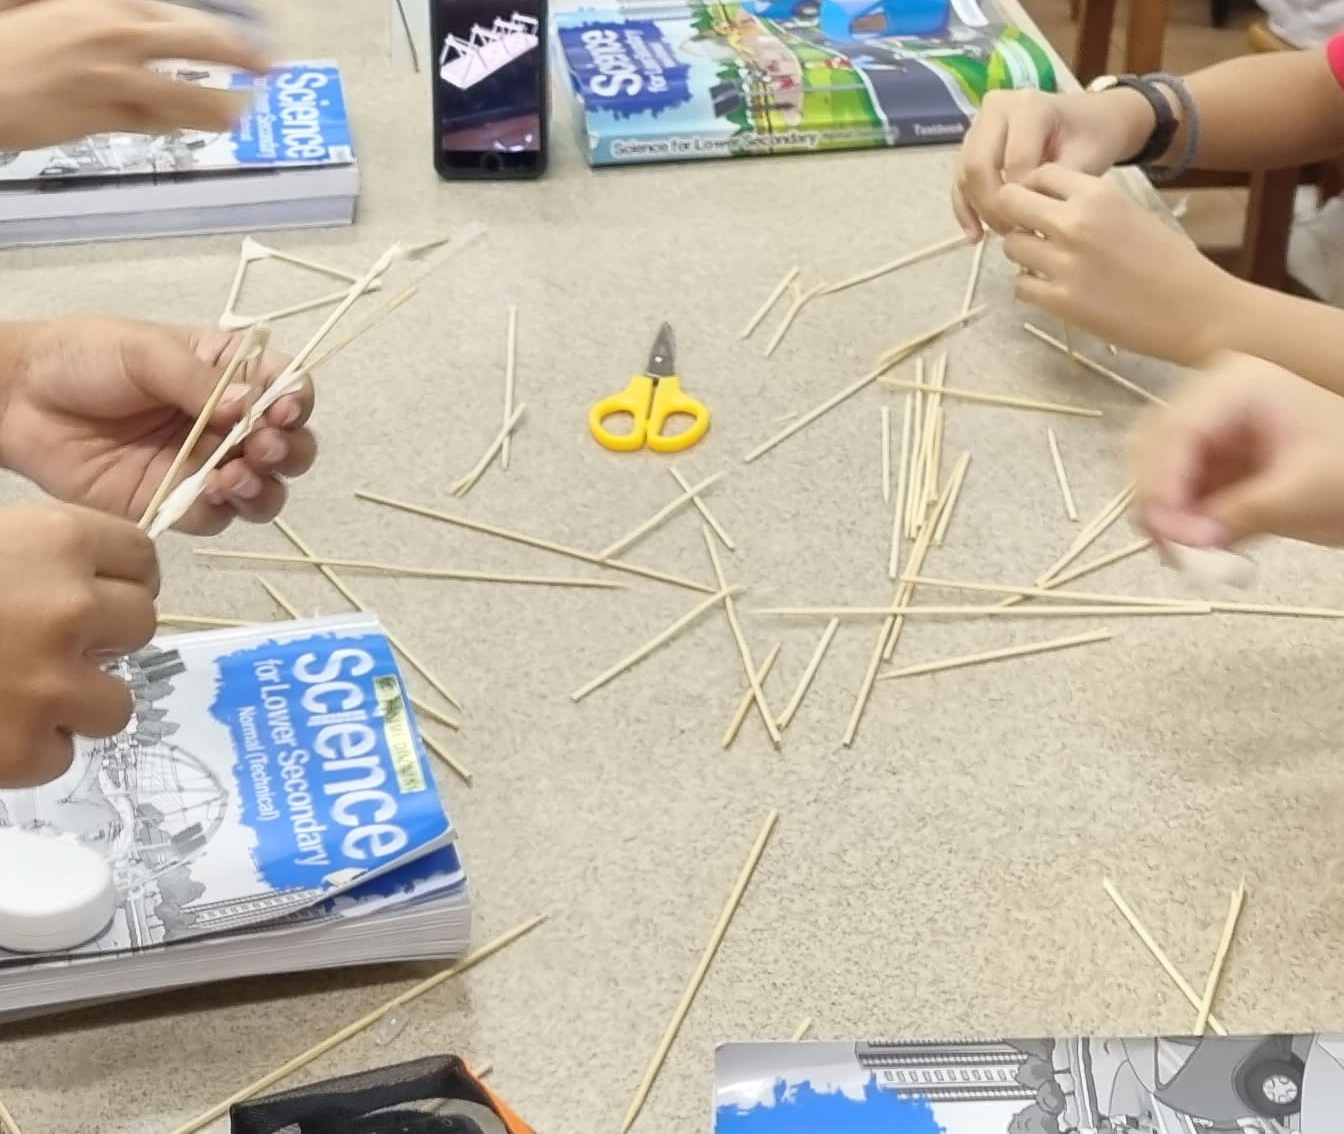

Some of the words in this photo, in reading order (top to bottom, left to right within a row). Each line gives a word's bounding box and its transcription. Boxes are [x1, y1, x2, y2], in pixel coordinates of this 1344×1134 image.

[276, 72, 331, 159] Science
[611, 139, 669, 157] Science
[671, 137, 691, 153] for
[693, 133, 742, 151] Lower
[743, 129, 819, 149] Secondary
[912, 123, 965, 137] Textbook
[253, 658, 284, 683] for
[238, 706, 262, 747] Normal
[260, 683, 297, 747] Lower
[245, 746, 280, 821] (Technical)
[292, 648, 408, 860] Science
[277, 749, 332, 866] Secondary
